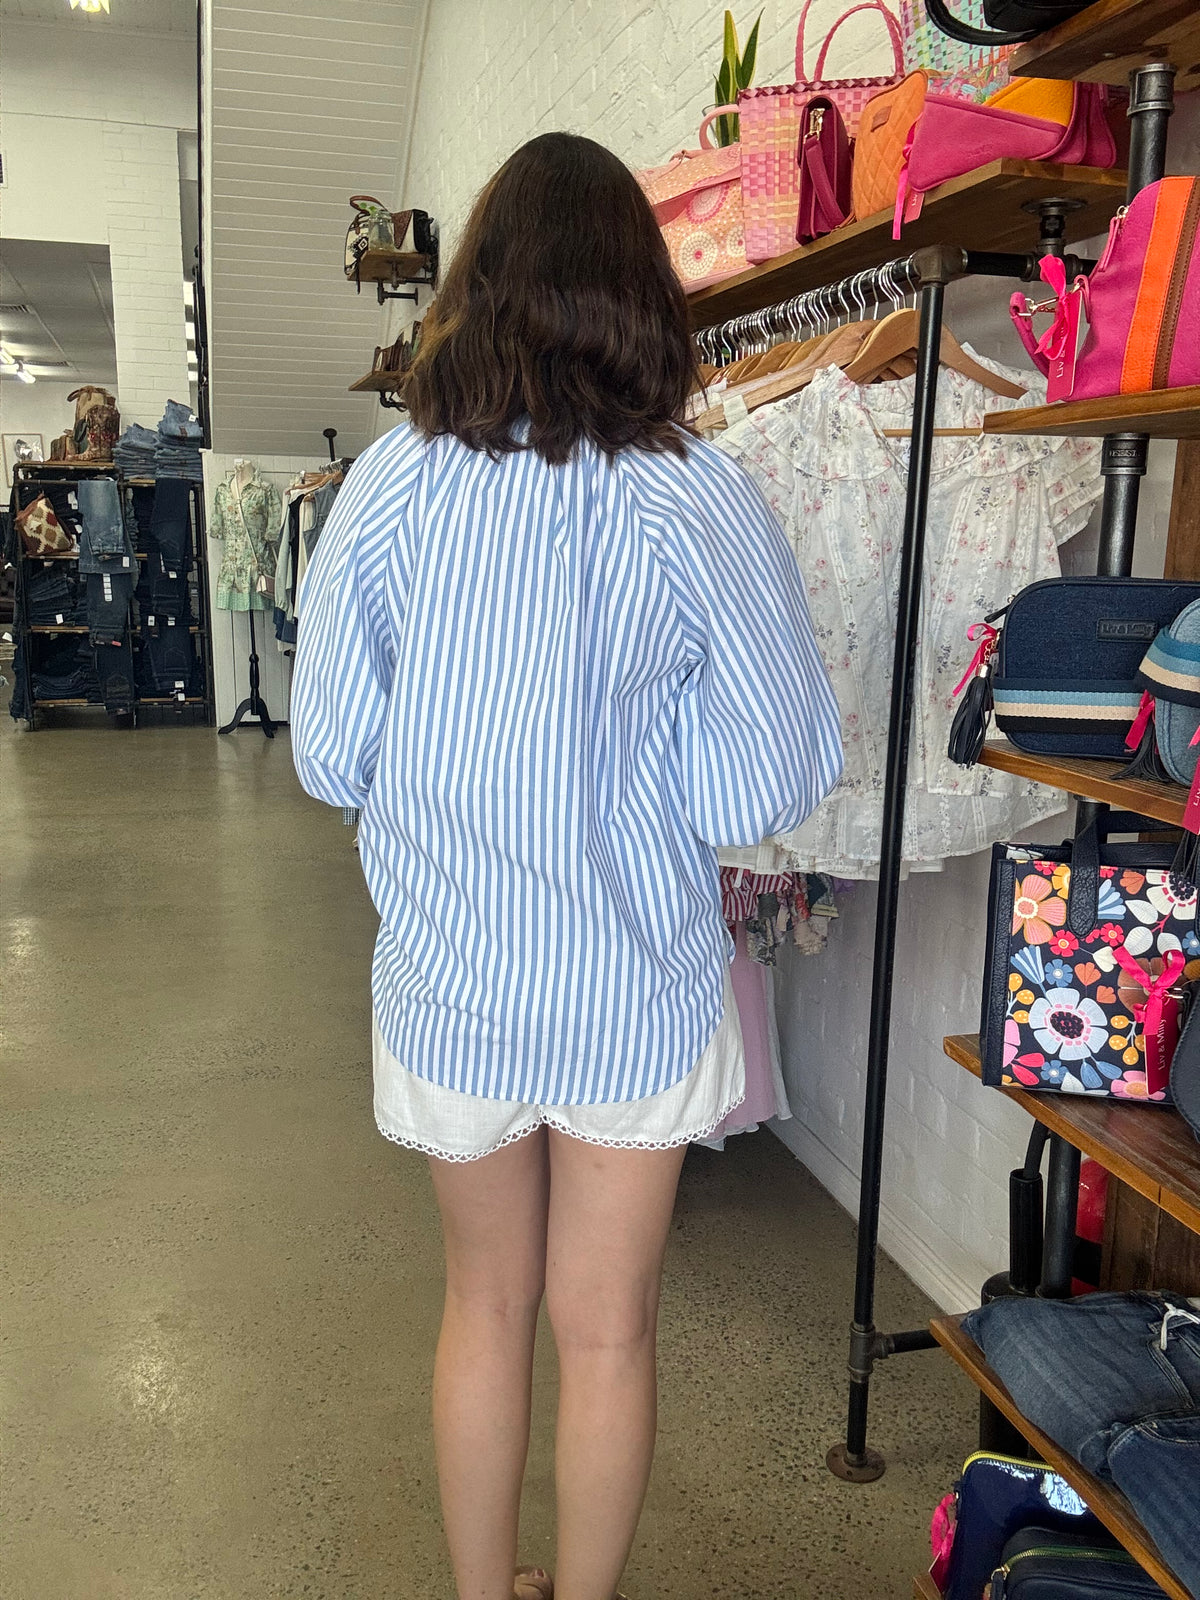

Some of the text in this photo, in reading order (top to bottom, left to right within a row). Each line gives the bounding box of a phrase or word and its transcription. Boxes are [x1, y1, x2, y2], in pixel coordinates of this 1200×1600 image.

[1056, 361, 1064, 378] Liv
[1157, 1019, 1166, 1071] Liv & Milly
